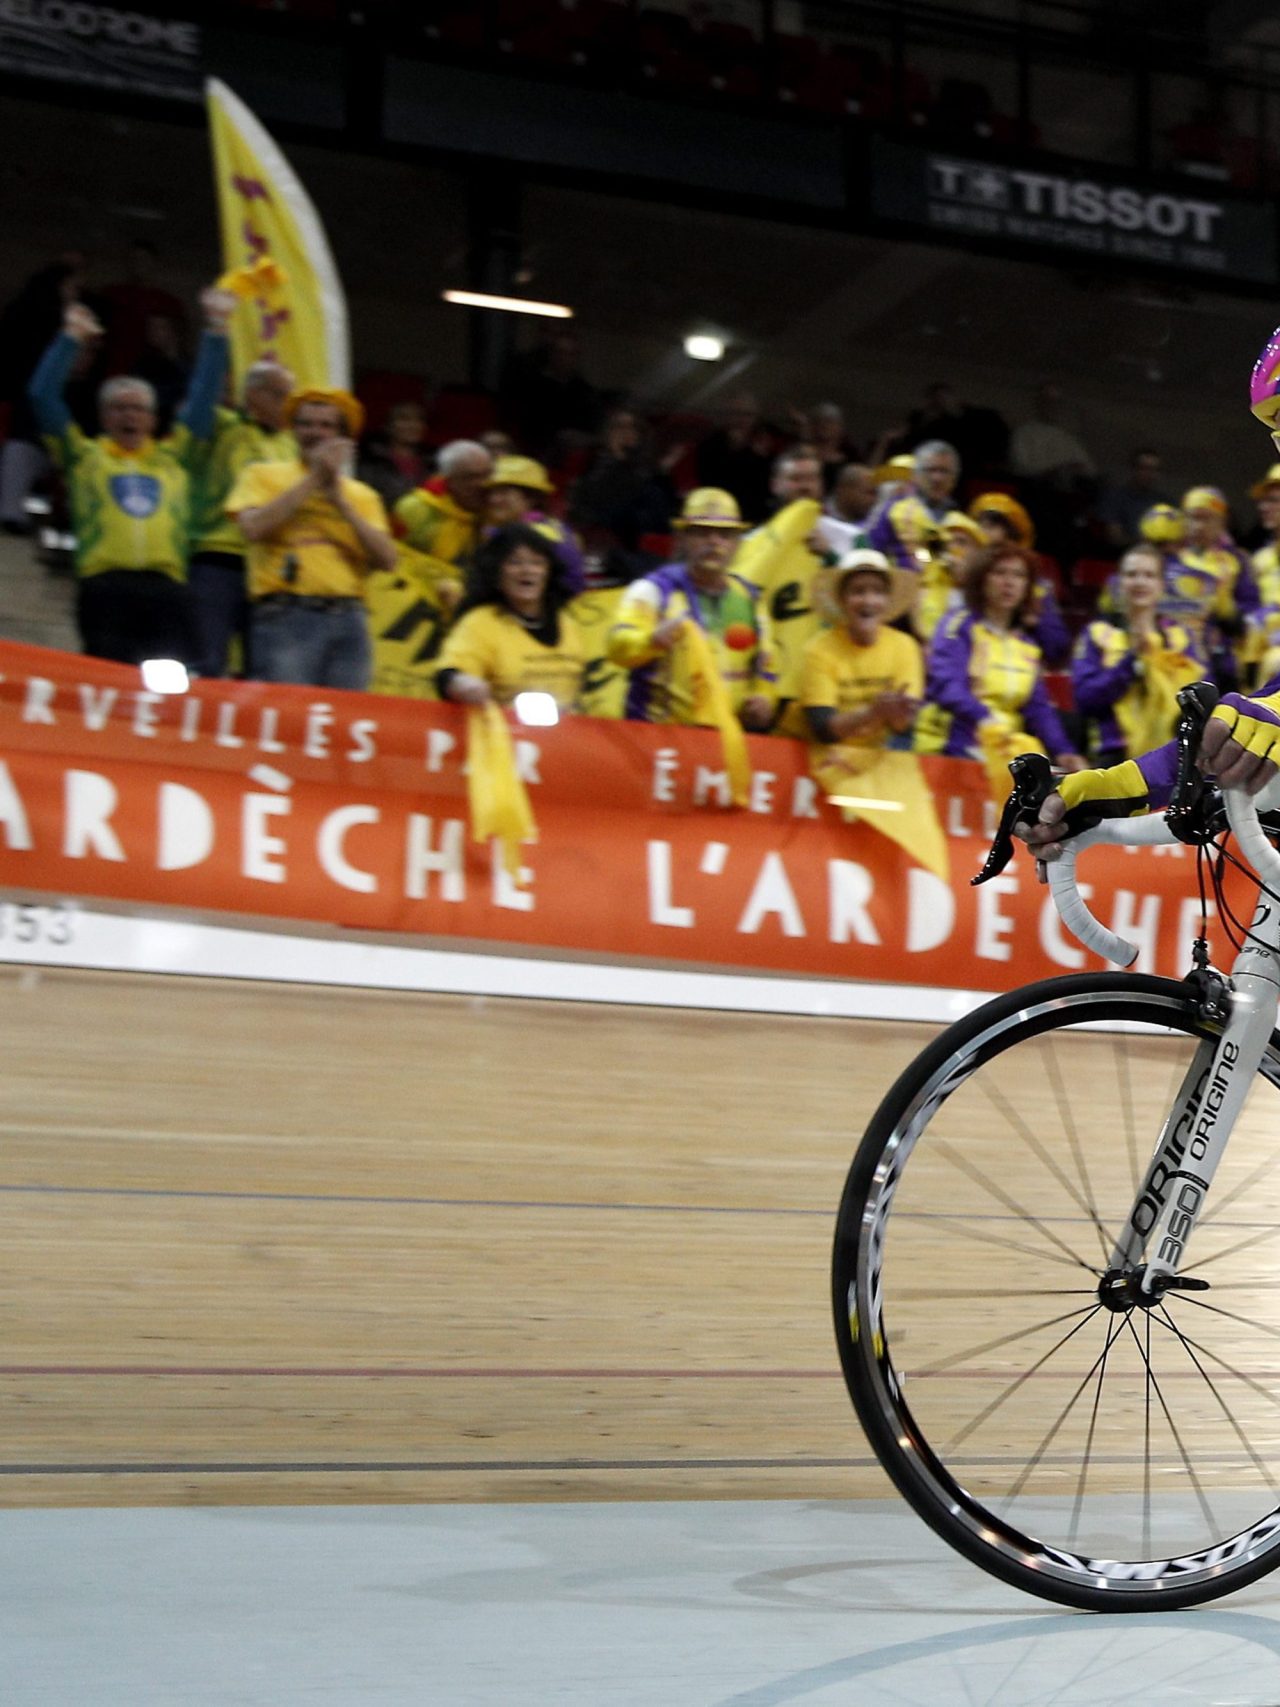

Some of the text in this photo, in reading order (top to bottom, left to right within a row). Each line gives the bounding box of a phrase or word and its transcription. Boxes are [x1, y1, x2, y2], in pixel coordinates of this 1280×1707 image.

[1010, 169, 1223, 242] TISSOT
[0, 676, 379, 763] RVEILLÉS
[425, 728, 542, 785] PR
[648, 838, 1217, 978] L'ARDÈCHE
